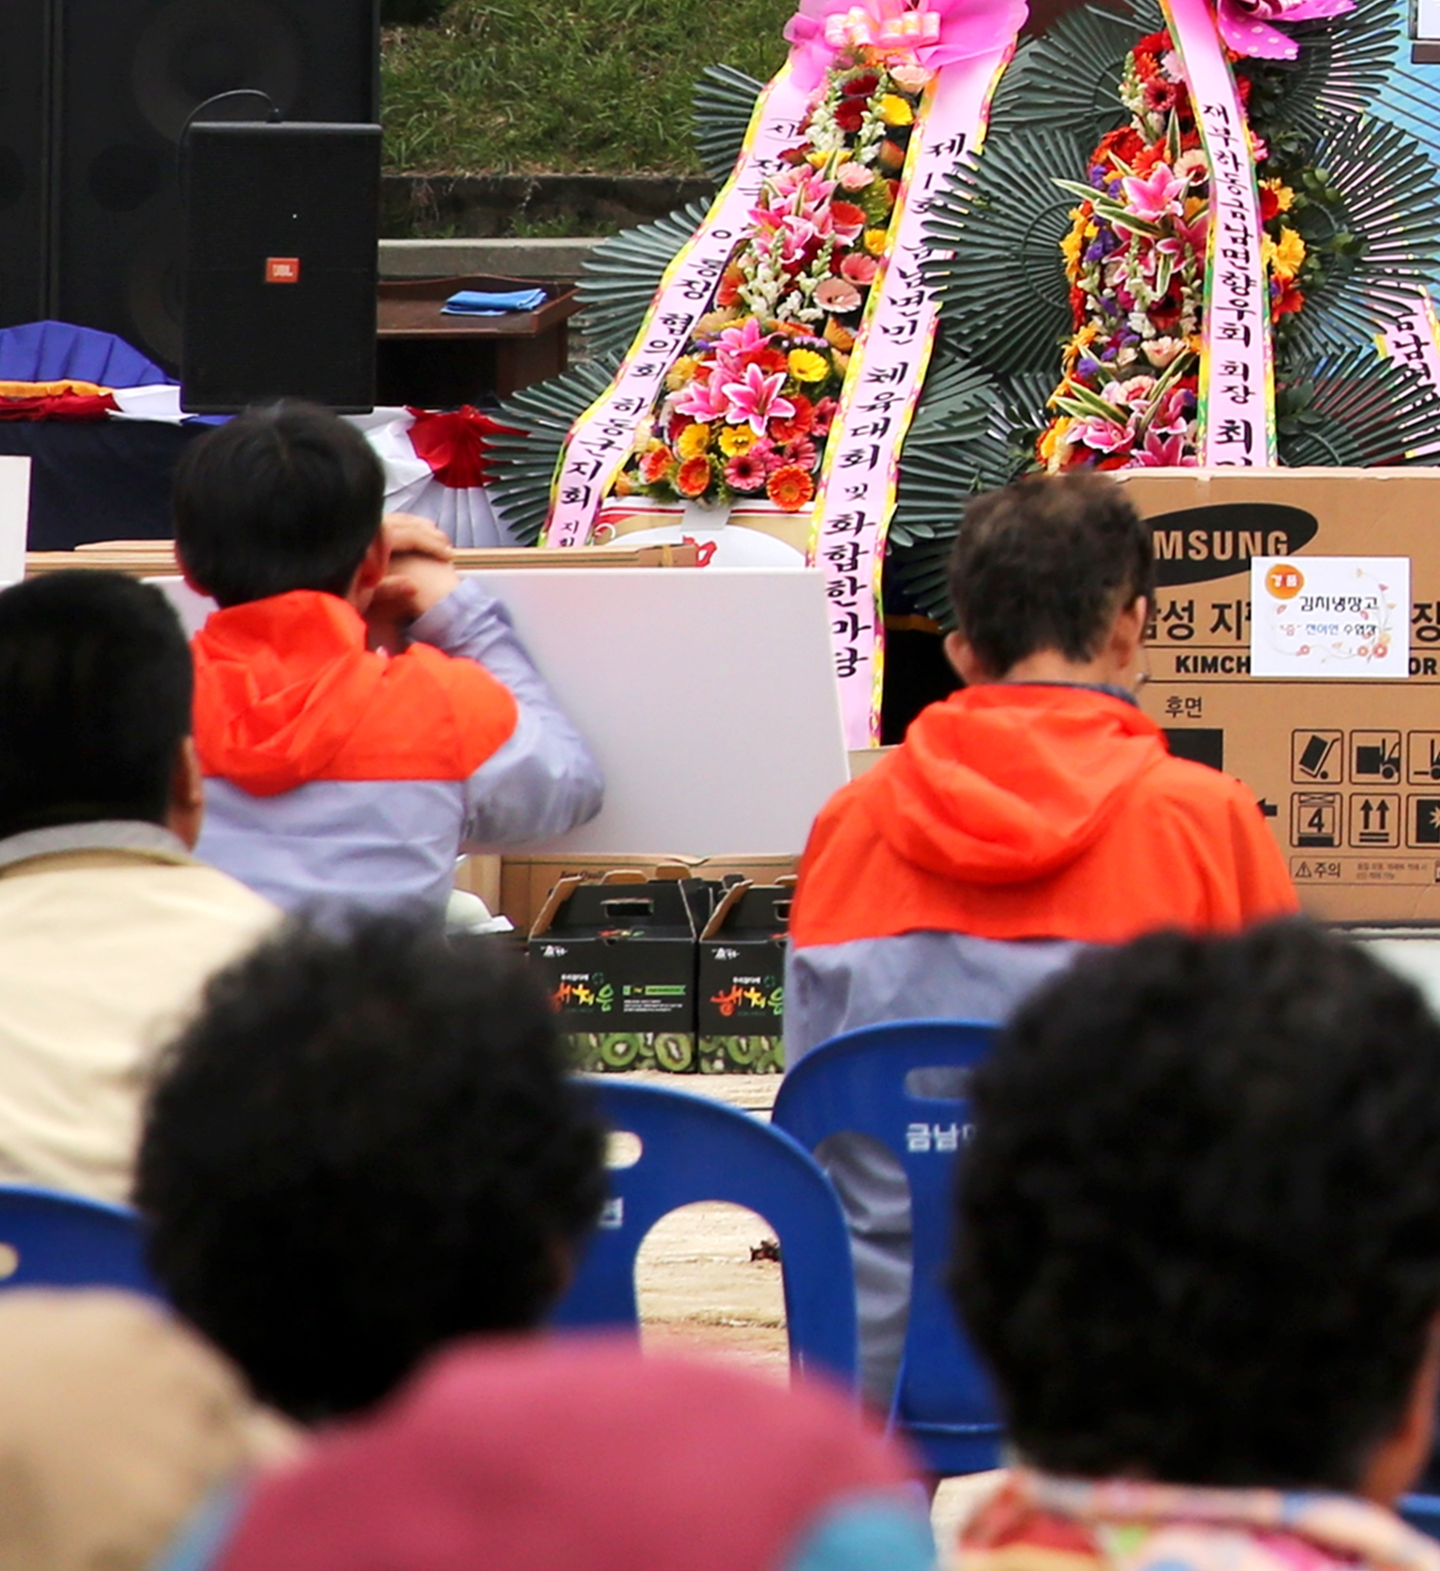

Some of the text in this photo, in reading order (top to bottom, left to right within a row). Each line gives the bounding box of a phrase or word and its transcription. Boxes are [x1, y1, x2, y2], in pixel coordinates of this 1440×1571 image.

[1153, 530, 1289, 561] MSUNG
[1300, 596, 1378, 613] 김치냉장고
[1165, 695, 1202, 719] 후면
[1314, 862, 1341, 879] 주의
